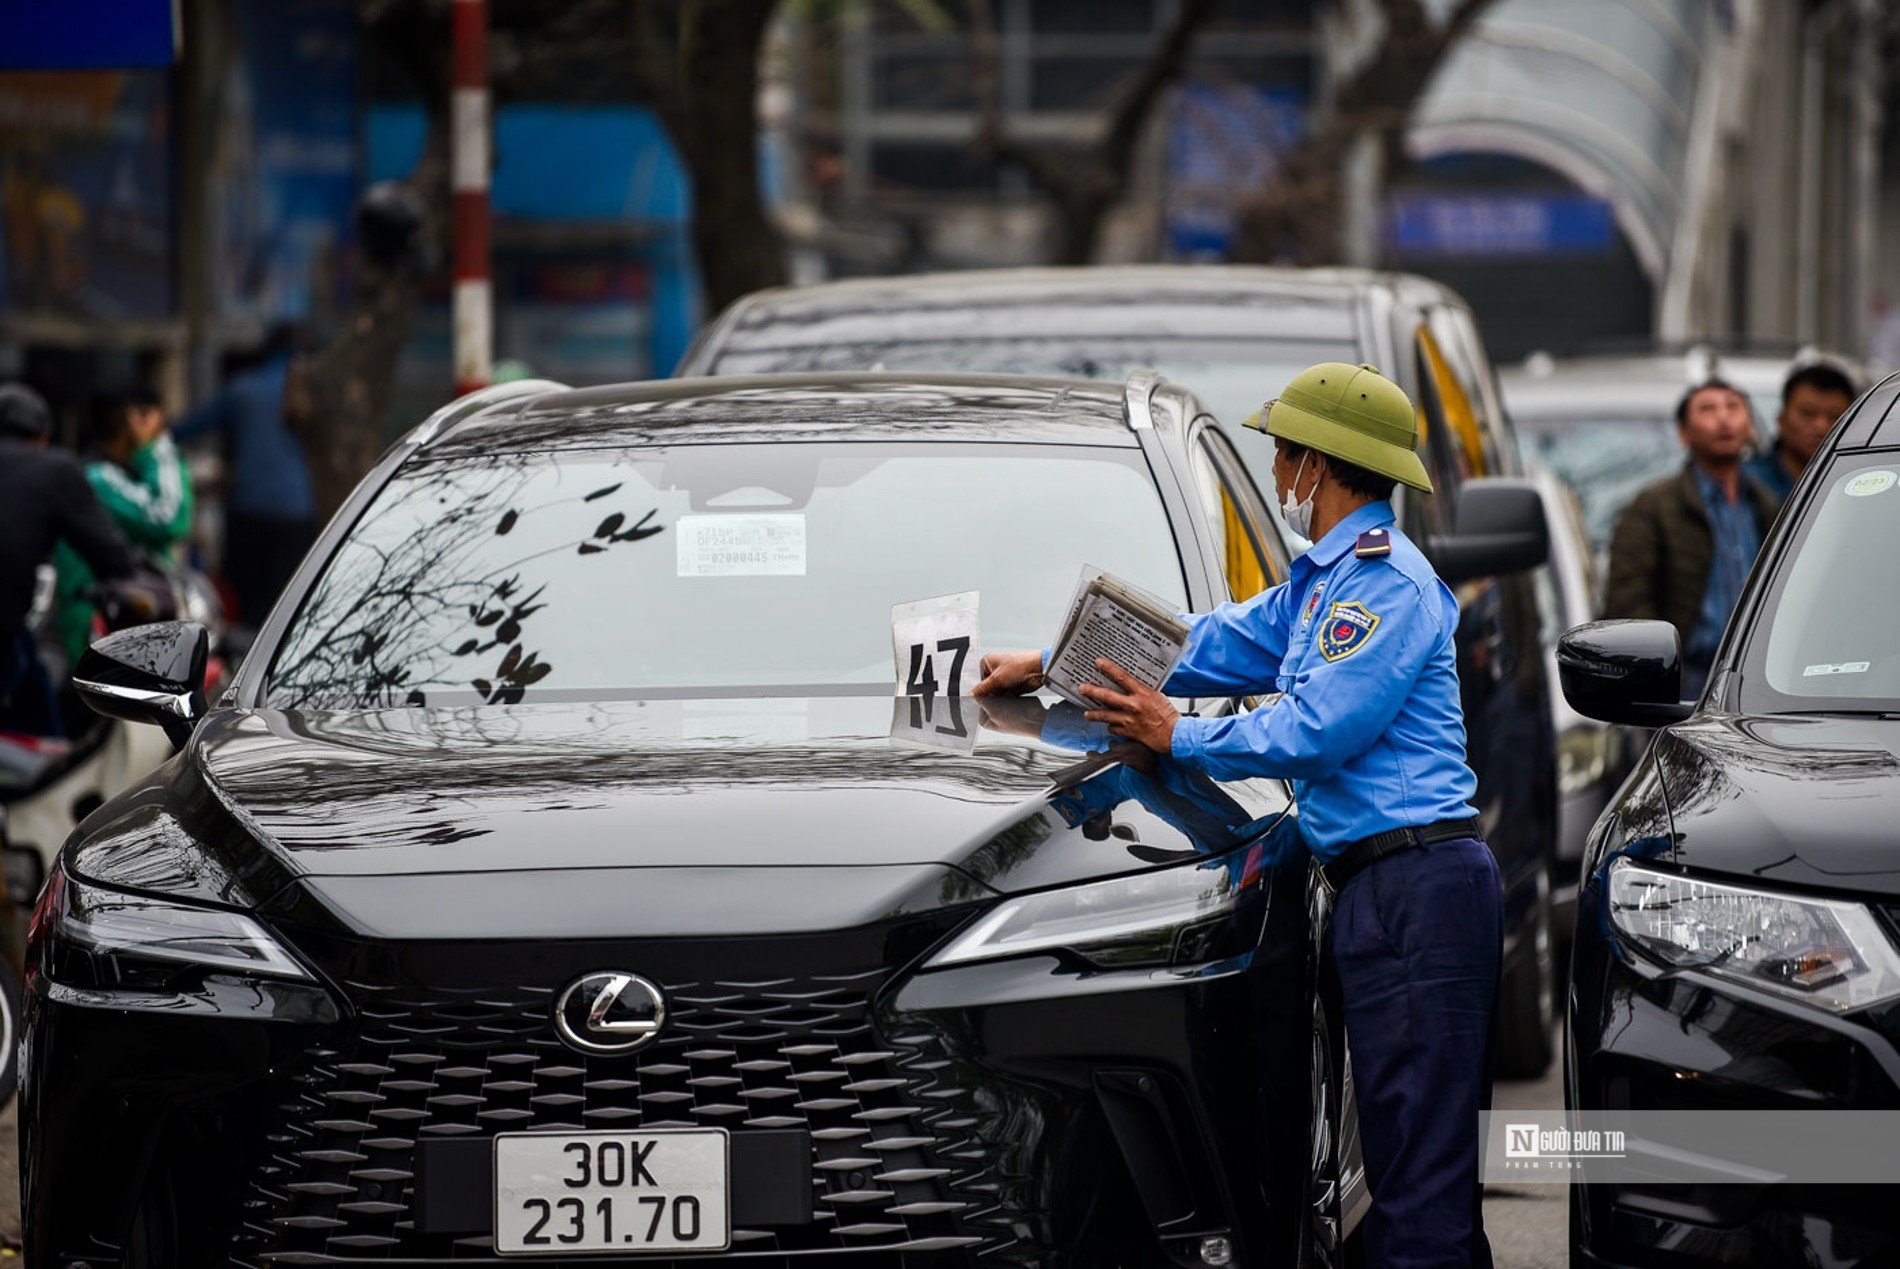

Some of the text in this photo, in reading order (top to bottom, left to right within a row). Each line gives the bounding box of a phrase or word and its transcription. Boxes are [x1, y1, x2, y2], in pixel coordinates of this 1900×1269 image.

[906, 636, 970, 697] 47
[563, 1140, 658, 1188] 30K
[523, 1195, 700, 1245] 231.70
